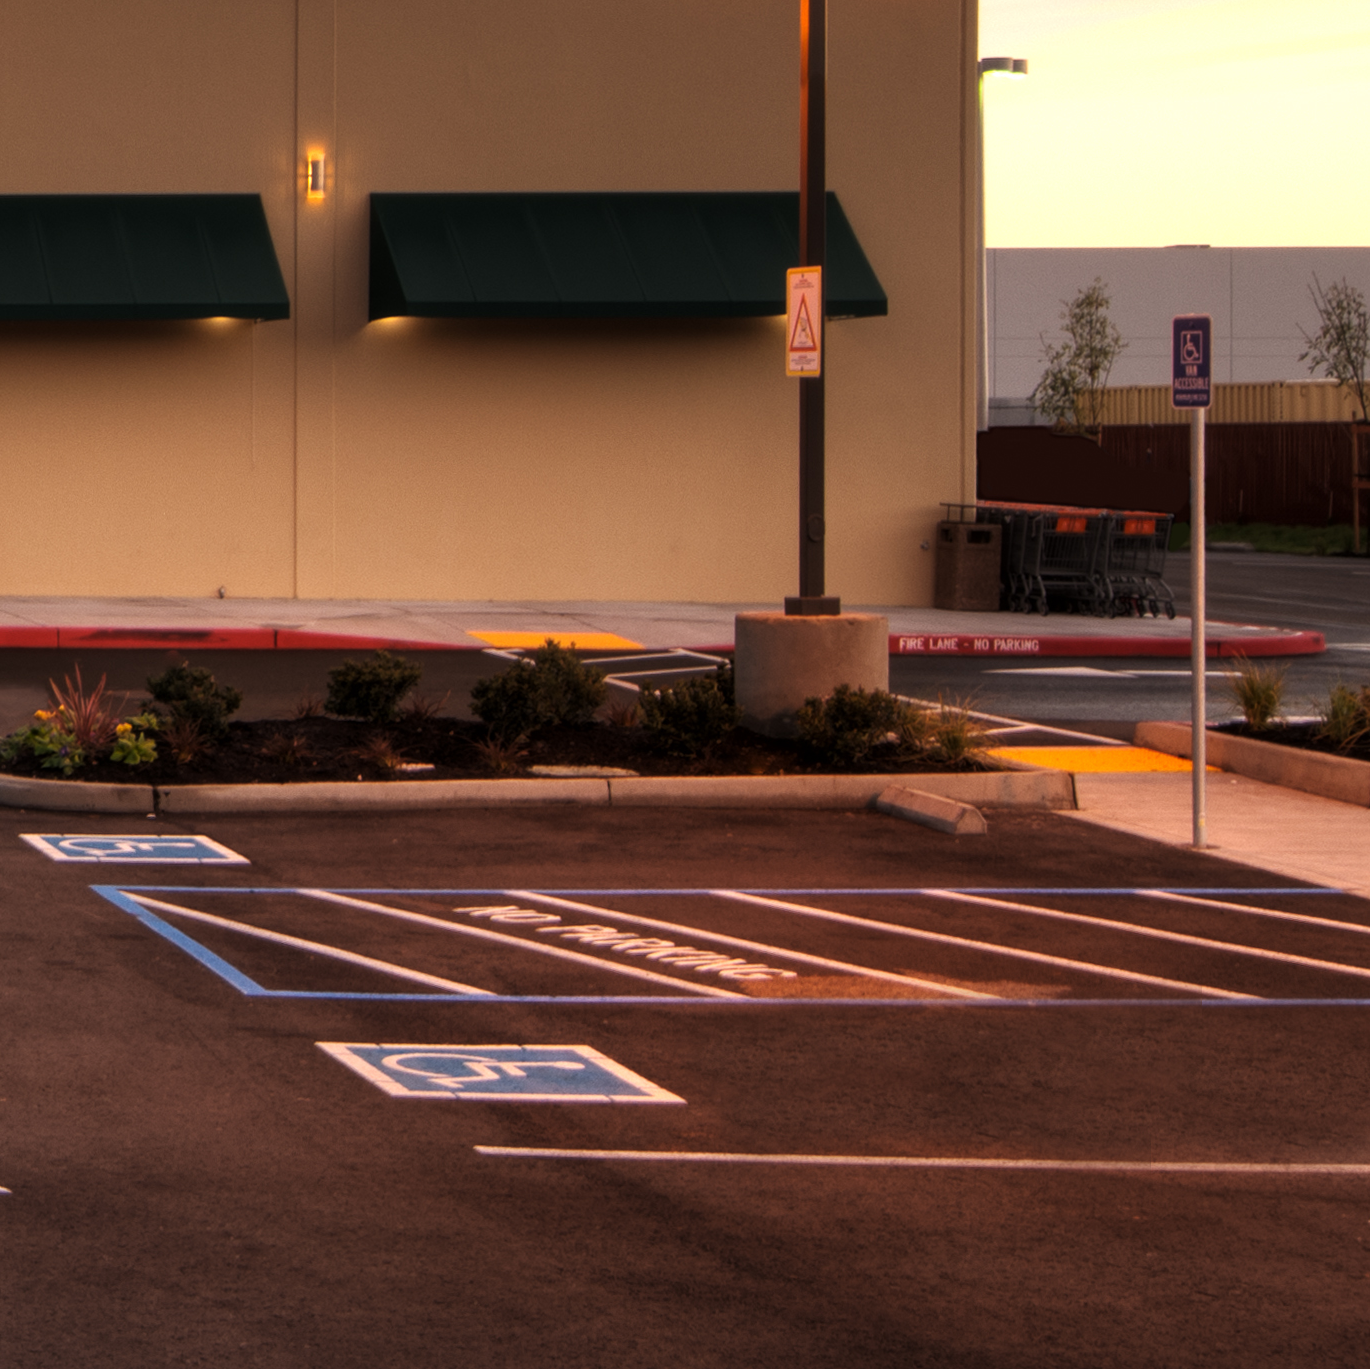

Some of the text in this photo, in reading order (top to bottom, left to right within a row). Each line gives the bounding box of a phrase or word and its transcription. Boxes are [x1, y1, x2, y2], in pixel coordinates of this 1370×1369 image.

[899, 637, 925, 652] FIRE
[929, 637, 959, 651] LANE
[974, 638, 990, 651] NO
[994, 638, 1040, 651] PARKING
[452, 905, 798, 980] NO PARKING
